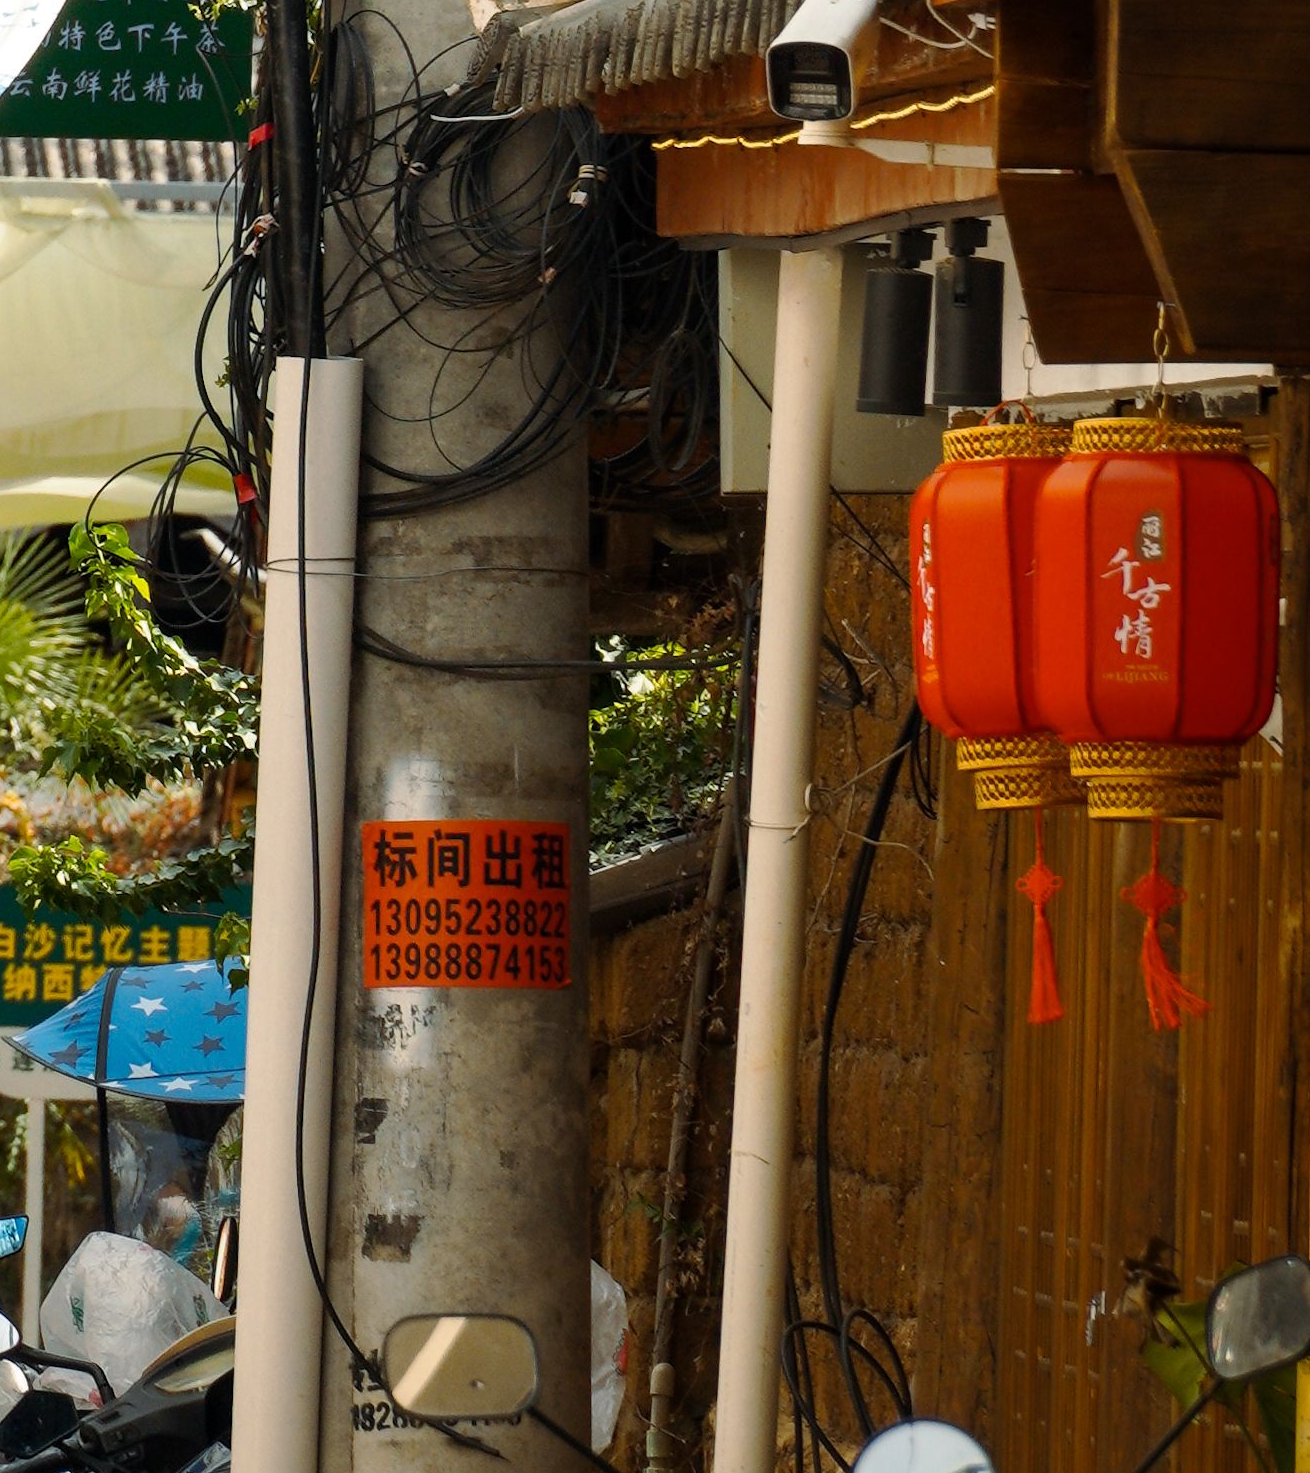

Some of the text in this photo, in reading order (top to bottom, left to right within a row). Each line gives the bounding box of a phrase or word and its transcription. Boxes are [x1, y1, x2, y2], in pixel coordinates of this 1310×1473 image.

[40, 19, 226, 54] 特色下午茶
[9, 67, 204, 103] 云南鲜花精油
[373, 828, 567, 889] 标间出租
[370, 898, 566, 938] 13095238822
[370, 942, 567, 982] 13988874153
